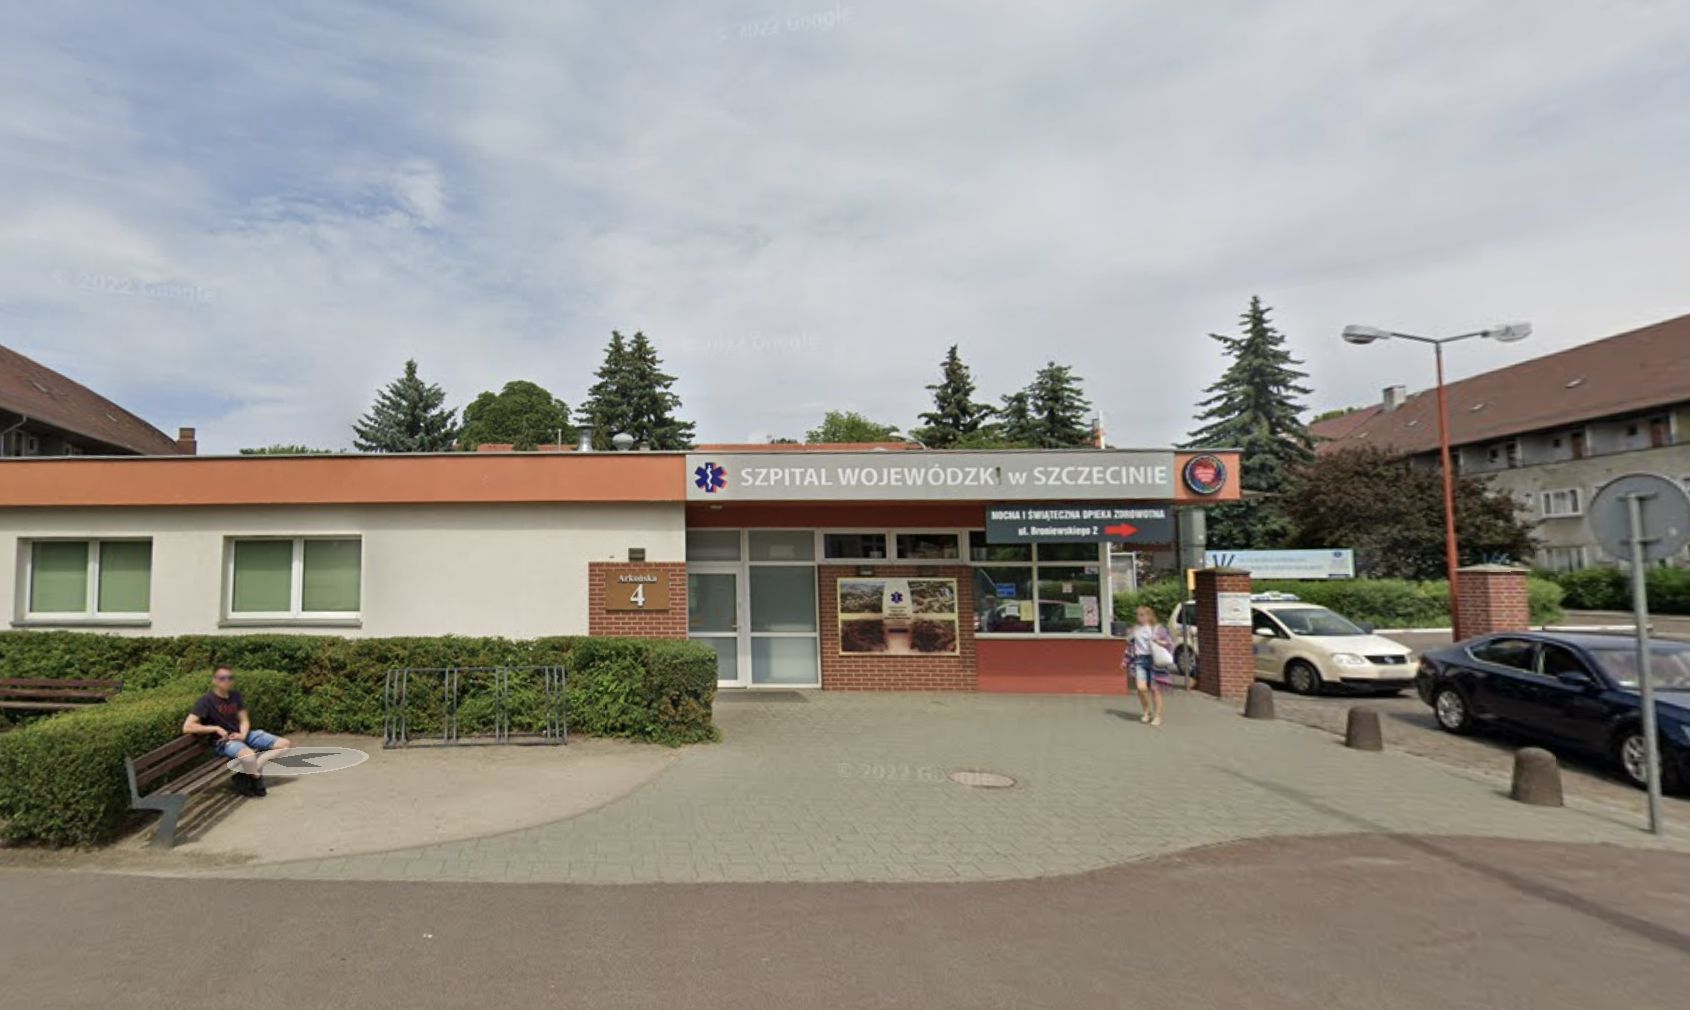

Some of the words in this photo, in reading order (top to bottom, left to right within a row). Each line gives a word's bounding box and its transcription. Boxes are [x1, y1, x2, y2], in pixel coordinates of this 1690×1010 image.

[741, 467, 833, 486] SZPITAL
[1008, 471, 1027, 485] w
[1033, 466, 1168, 486] SZCZECINIE
[991, 510, 1021, 520] NOCNA
[1083, 510, 1112, 519] OPIEKA
[1114, 509, 1166, 519] ZDROWOTNA
[630, 583, 646, 606] 4
